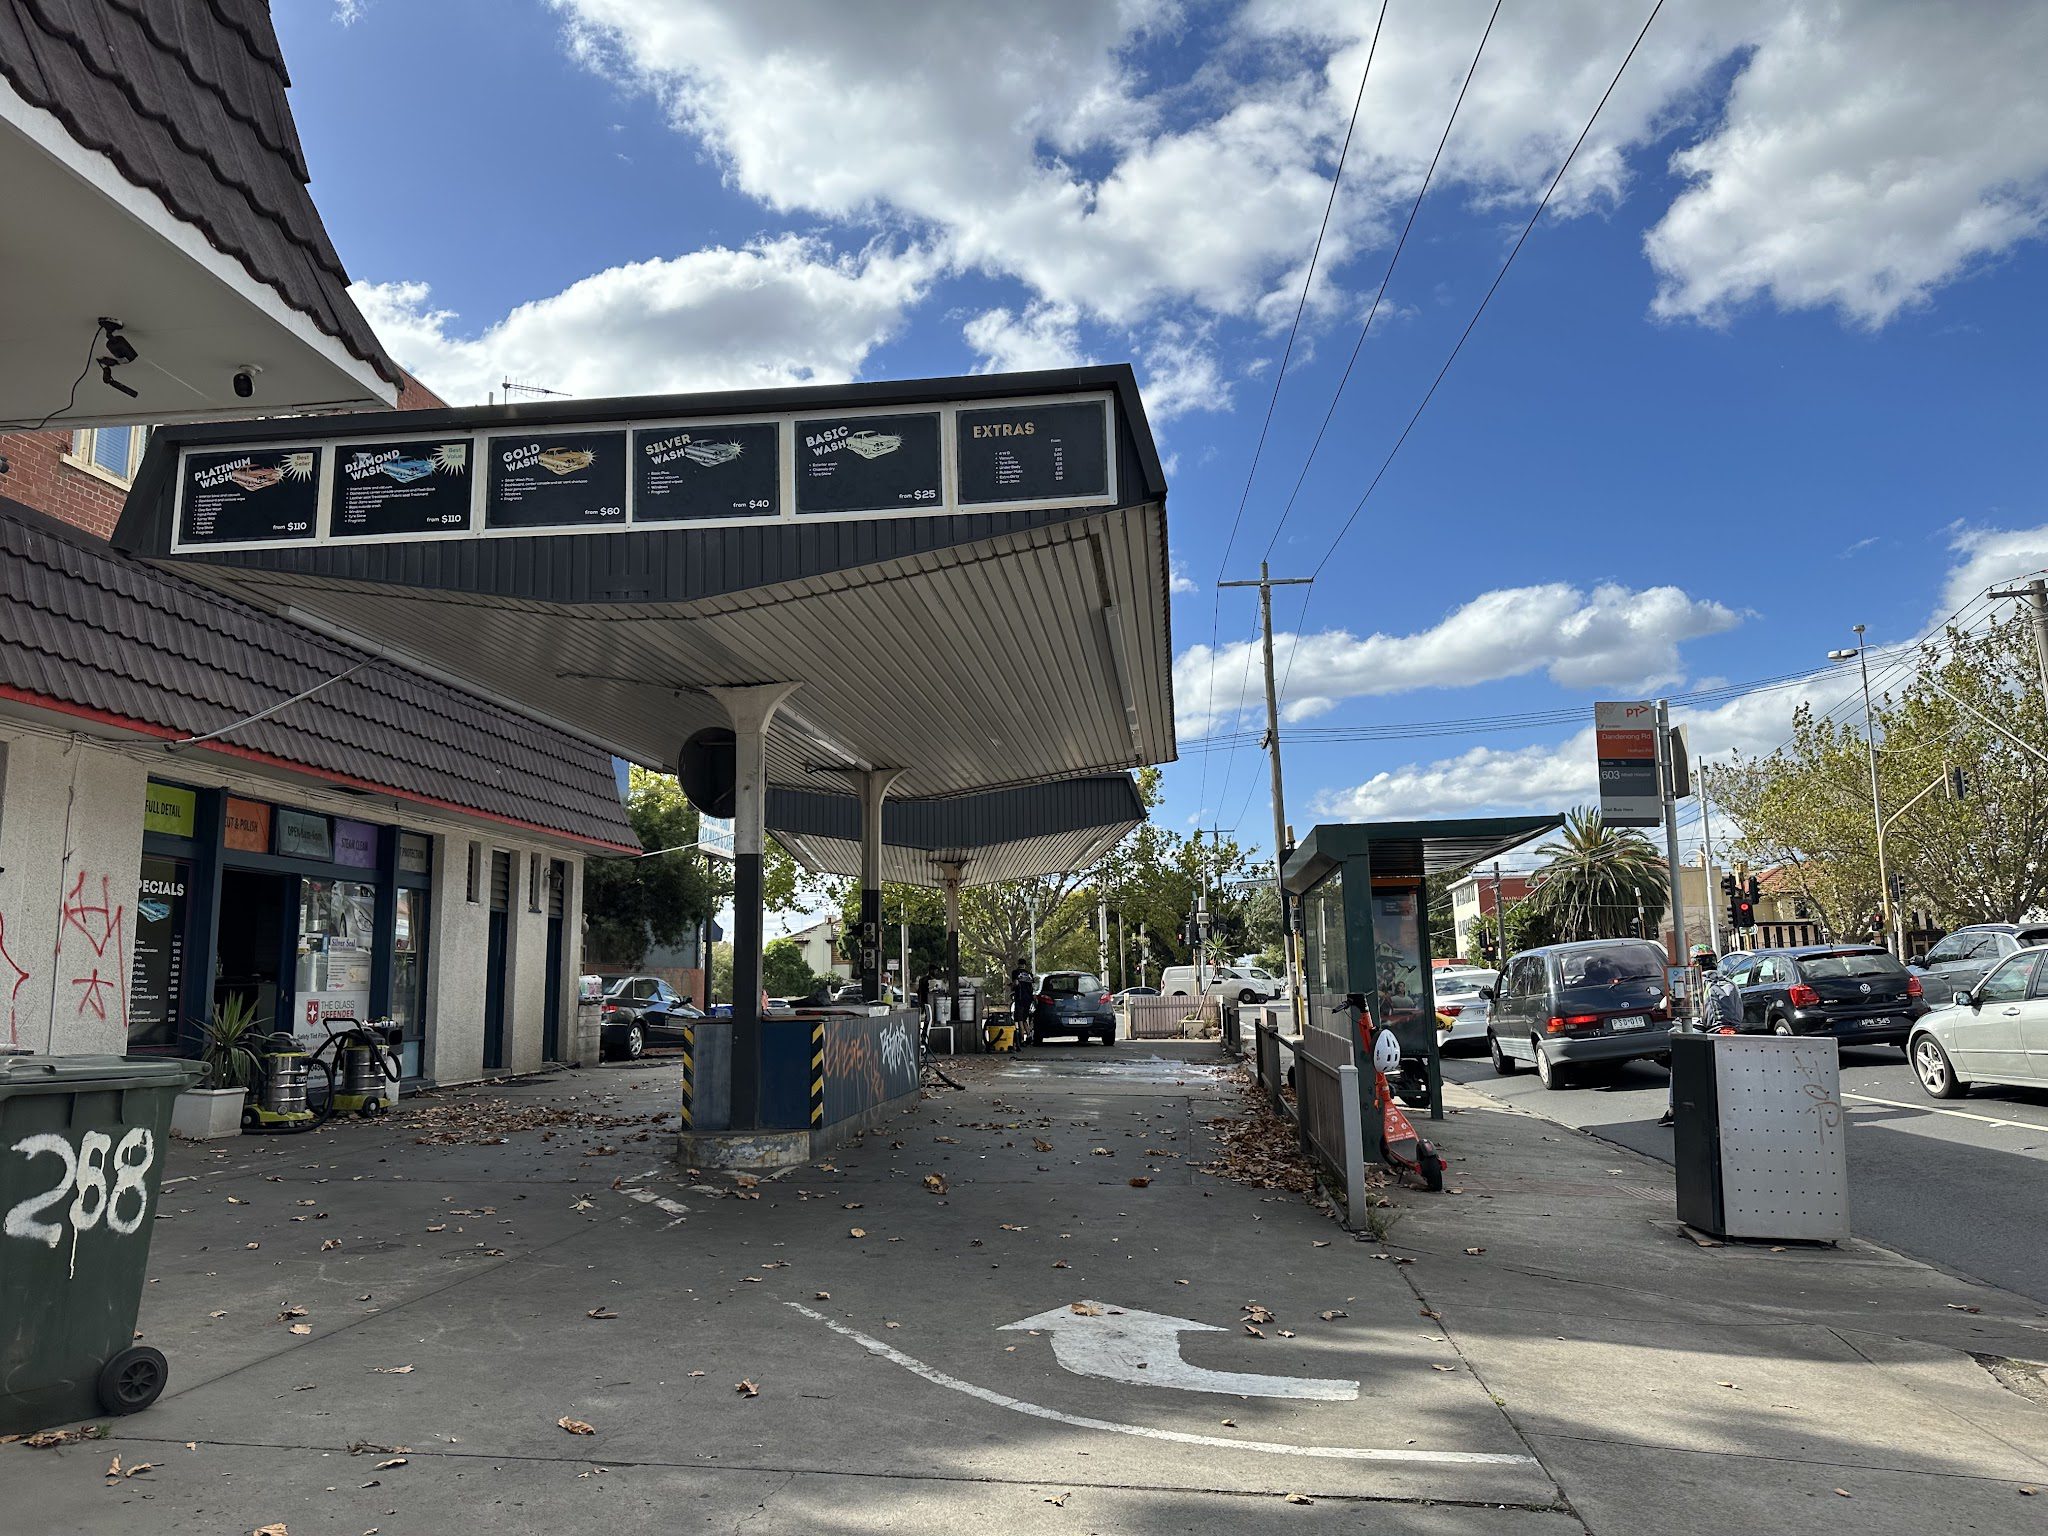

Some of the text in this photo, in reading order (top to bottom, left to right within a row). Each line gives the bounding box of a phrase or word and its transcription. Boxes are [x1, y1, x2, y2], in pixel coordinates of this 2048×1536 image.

[805, 426, 848, 447] BASIC
[973, 422, 1035, 438] EXTRAS
[645, 434, 691, 455] SILVER
[812, 439, 846, 456] WASH
[345, 450, 400, 473] DIAMOND
[502, 444, 540, 463] GOLD
[651, 448, 685, 464] WASH
[194, 457, 251, 482] PLATINUM
[506, 455, 538, 472] WASH
[200, 472, 233, 488] WASH
[350, 464, 384, 481] WASH
[914, 490, 936, 500] $25
[600, 507, 620, 516] $60
[749, 500, 769, 509] $40
[287, 522, 307, 531] $110
[441, 515, 462, 524] $110
[1602, 770, 1620, 780] 603
[145, 800, 181, 818] FULL DETAIL
[240, 818, 258, 832] POLISH
[288, 825, 300, 838] OPEN
[138, 879, 185, 897] PECIALS
[331, 938, 356, 947] Silver Seal
[335, 1000, 354, 1009] GLASS
[321, 1010, 354, 1018] DEFENDER
